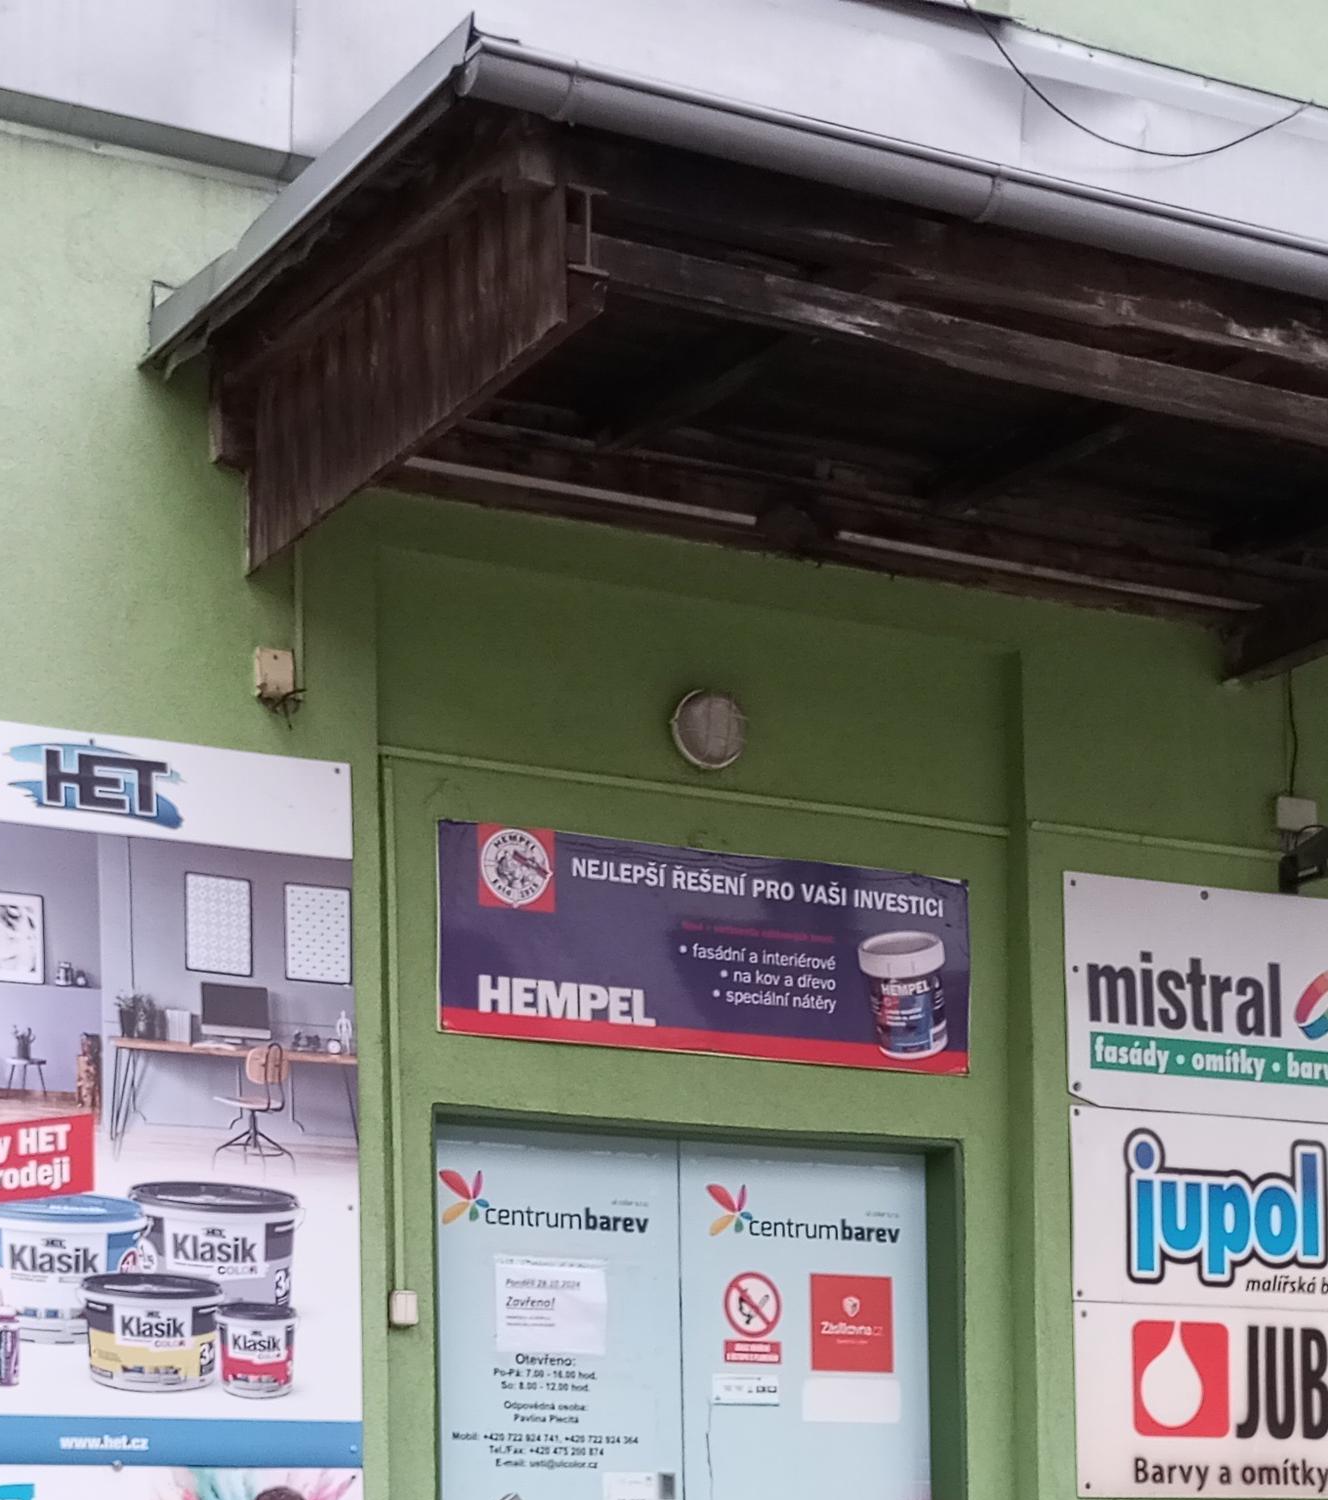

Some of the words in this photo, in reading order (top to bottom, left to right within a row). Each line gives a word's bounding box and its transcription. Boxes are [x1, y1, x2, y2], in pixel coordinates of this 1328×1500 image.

[43, 745, 169, 817] HET
[572, 856, 666, 888] NEJLEPŠÍ
[672, 865, 747, 897] ŘEŠENÍ
[752, 878, 794, 901] PRO
[800, 880, 847, 907] VAŠI
[853, 889, 944, 918] INVESTICI
[692, 943, 746, 962] fasádní
[749, 952, 758, 964] a
[762, 950, 836, 970] interiérové
[733, 971, 751, 983] na
[755, 970, 780, 986] kov
[784, 976, 793, 987] a
[797, 975, 836, 991] dřevo
[881, 980, 930, 996] HEMPEL
[478, 974, 657, 1027] HEMPEL
[726, 990, 790, 1007] speciální
[793, 994, 836, 1014] nátěry
[1087, 951, 1282, 1038] mistral
[1094, 1036, 1170, 1074] fasády
[1191, 1049, 1266, 1081] omítky
[18, 1123, 71, 1155] HET
[9, 1244, 99, 1274] Klasik
[173, 1233, 257, 1263] Klasik
[1245, 1274, 1316, 1295] malířská
[505, 1296, 555, 1308] Zavřeno!
[121, 1315, 185, 1339] Klasik
[232, 1334, 281, 1352] Klasik
[515, 1353, 576, 1367] Otevřeno:
[60, 1434, 149, 1451] www.het.cz
[1134, 1457, 1209, 1491] Barvy
[1219, 1465, 1231, 1484] a
